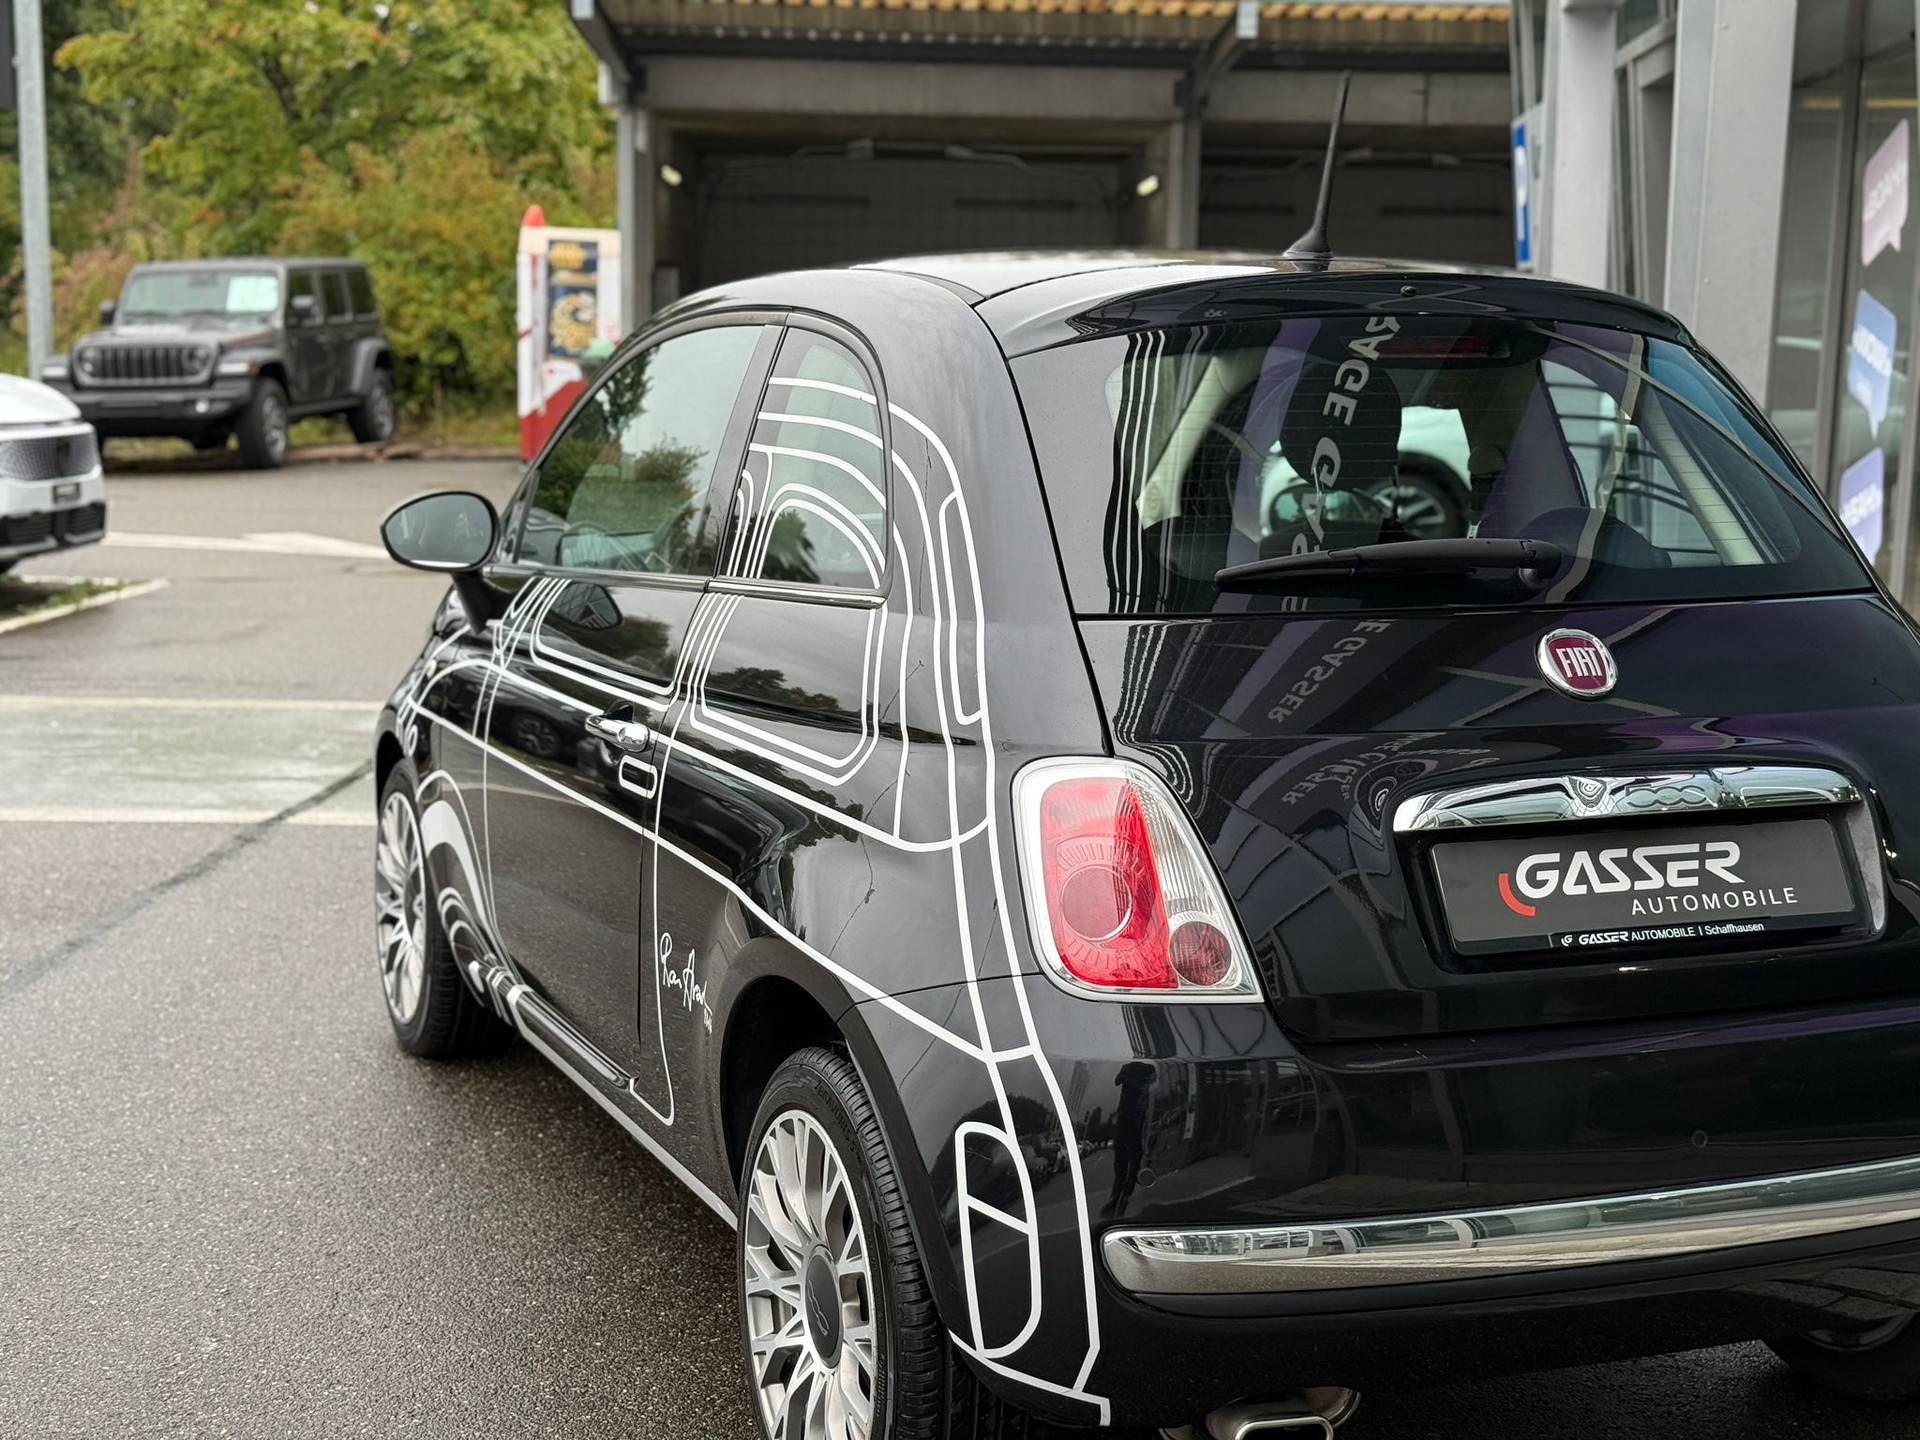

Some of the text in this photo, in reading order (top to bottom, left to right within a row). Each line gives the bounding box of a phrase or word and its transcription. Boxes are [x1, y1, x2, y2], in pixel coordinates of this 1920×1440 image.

[1555, 646, 1603, 678] FIAT
[1515, 840, 1746, 899] GASSER
[1631, 886, 1798, 916] AUTOMOBILE
[1578, 930, 1629, 946] GASSER
[1631, 926, 1696, 942] AUTOMOBILE
[1704, 922, 1765, 936] Schaffhausen
